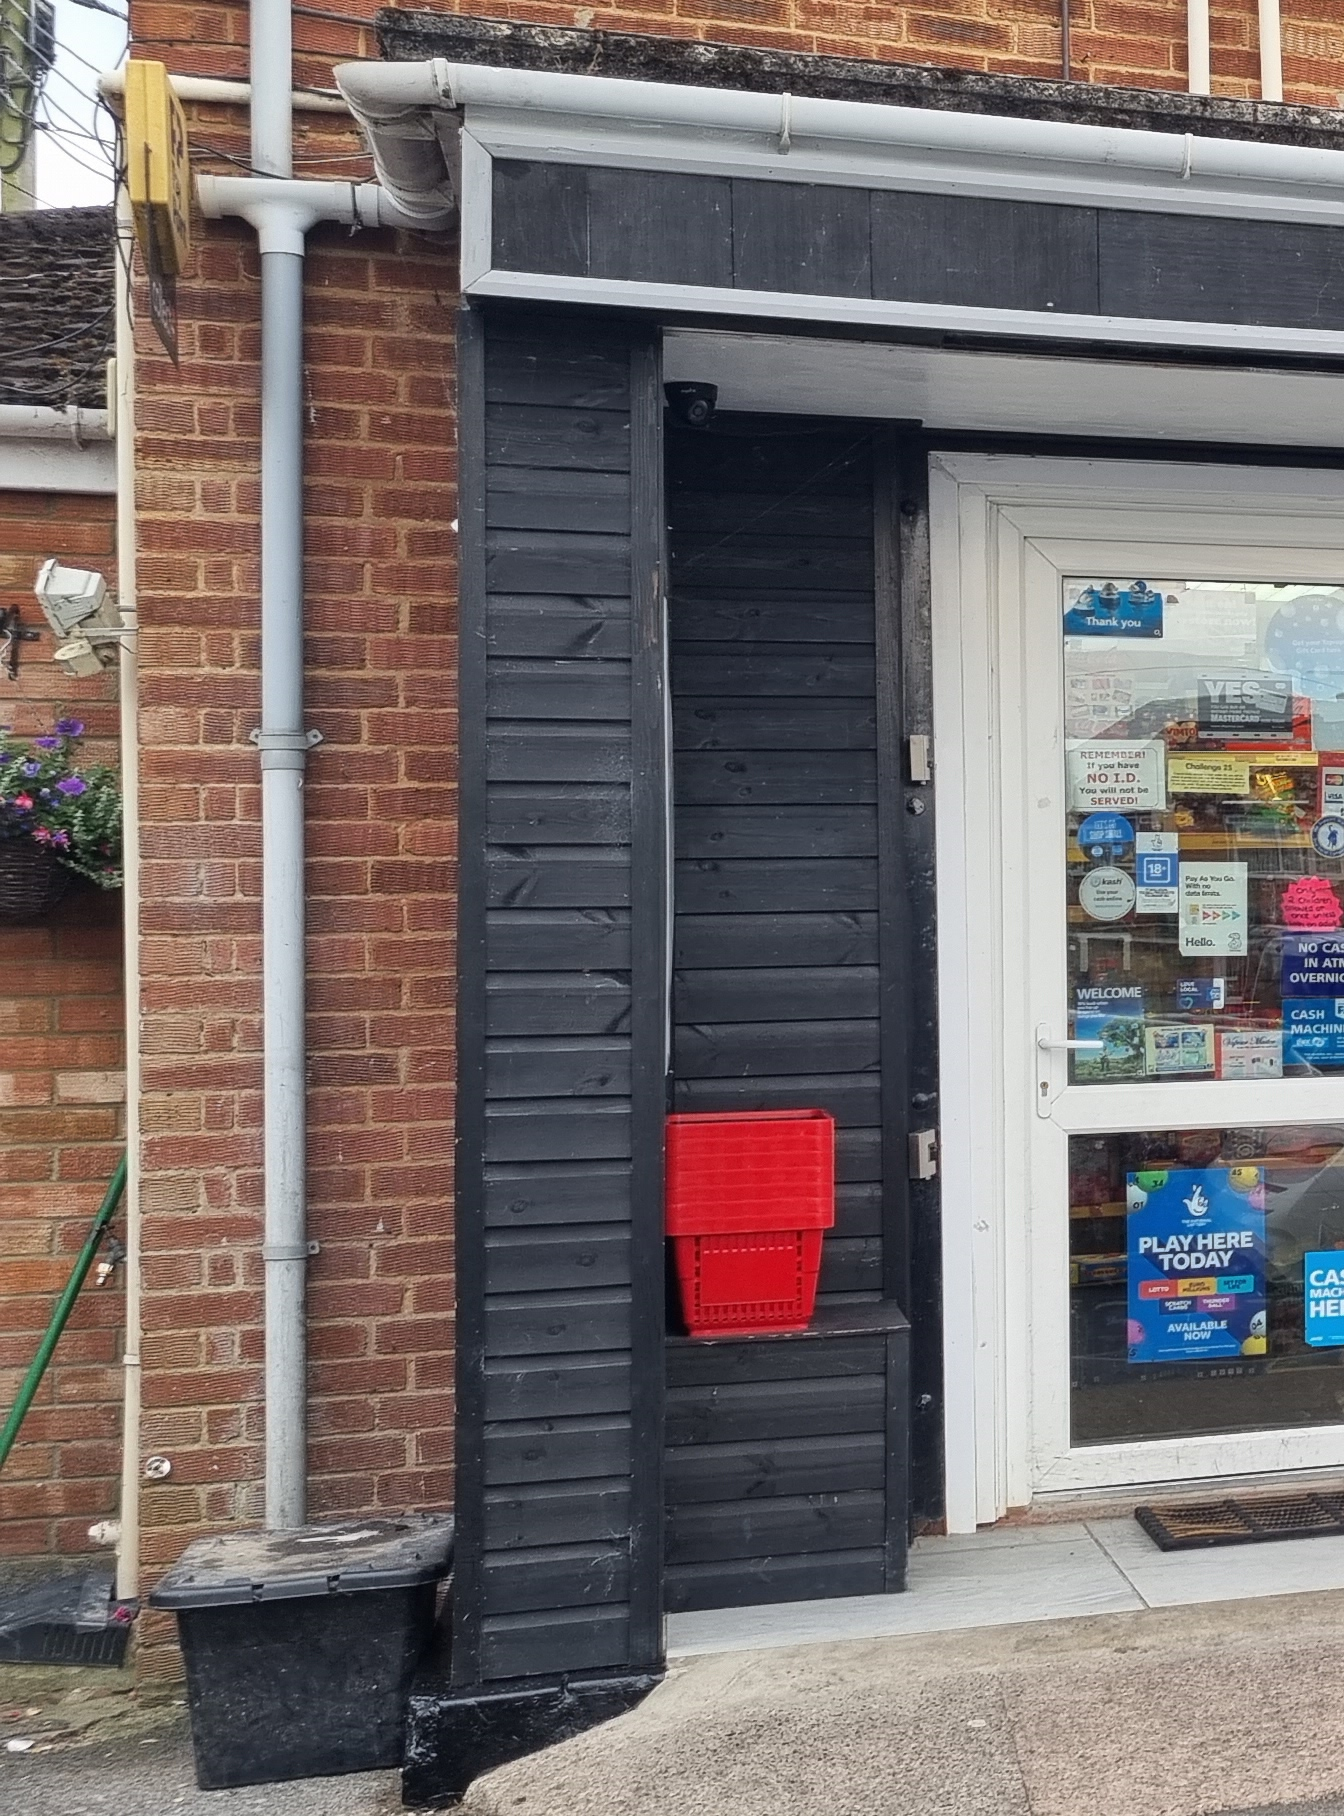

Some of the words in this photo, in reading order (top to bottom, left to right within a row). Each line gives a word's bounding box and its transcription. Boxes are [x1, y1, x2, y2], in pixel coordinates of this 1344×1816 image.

[1087, 617, 1118, 626] Thank
[1121, 620, 1141, 629] you
[1205, 681, 1260, 704] YES
[1167, 728, 1196, 736] VIMTO
[1080, 751, 1145, 759] REMEMBER!
[1186, 763, 1221, 771] Challenge
[1087, 773, 1108, 783] NO
[1114, 773, 1140, 783] I.D.
[1091, 797, 1138, 805] SERVED!
[1185, 937, 1216, 947] Hello.
[1298, 943, 1317, 953] NO
[1304, 958, 1318, 968] IN
[1076, 987, 1142, 999] WELCOME
[1291, 1010, 1325, 1020] CASH
[1139, 1234, 1195, 1254] PLAY
[1197, 1231, 1254, 1250] HERE
[1159, 1250, 1234, 1271] TODAY
[1167, 1320, 1228, 1333] AVAILABLE
[1184, 1331, 1211, 1341] NOW
